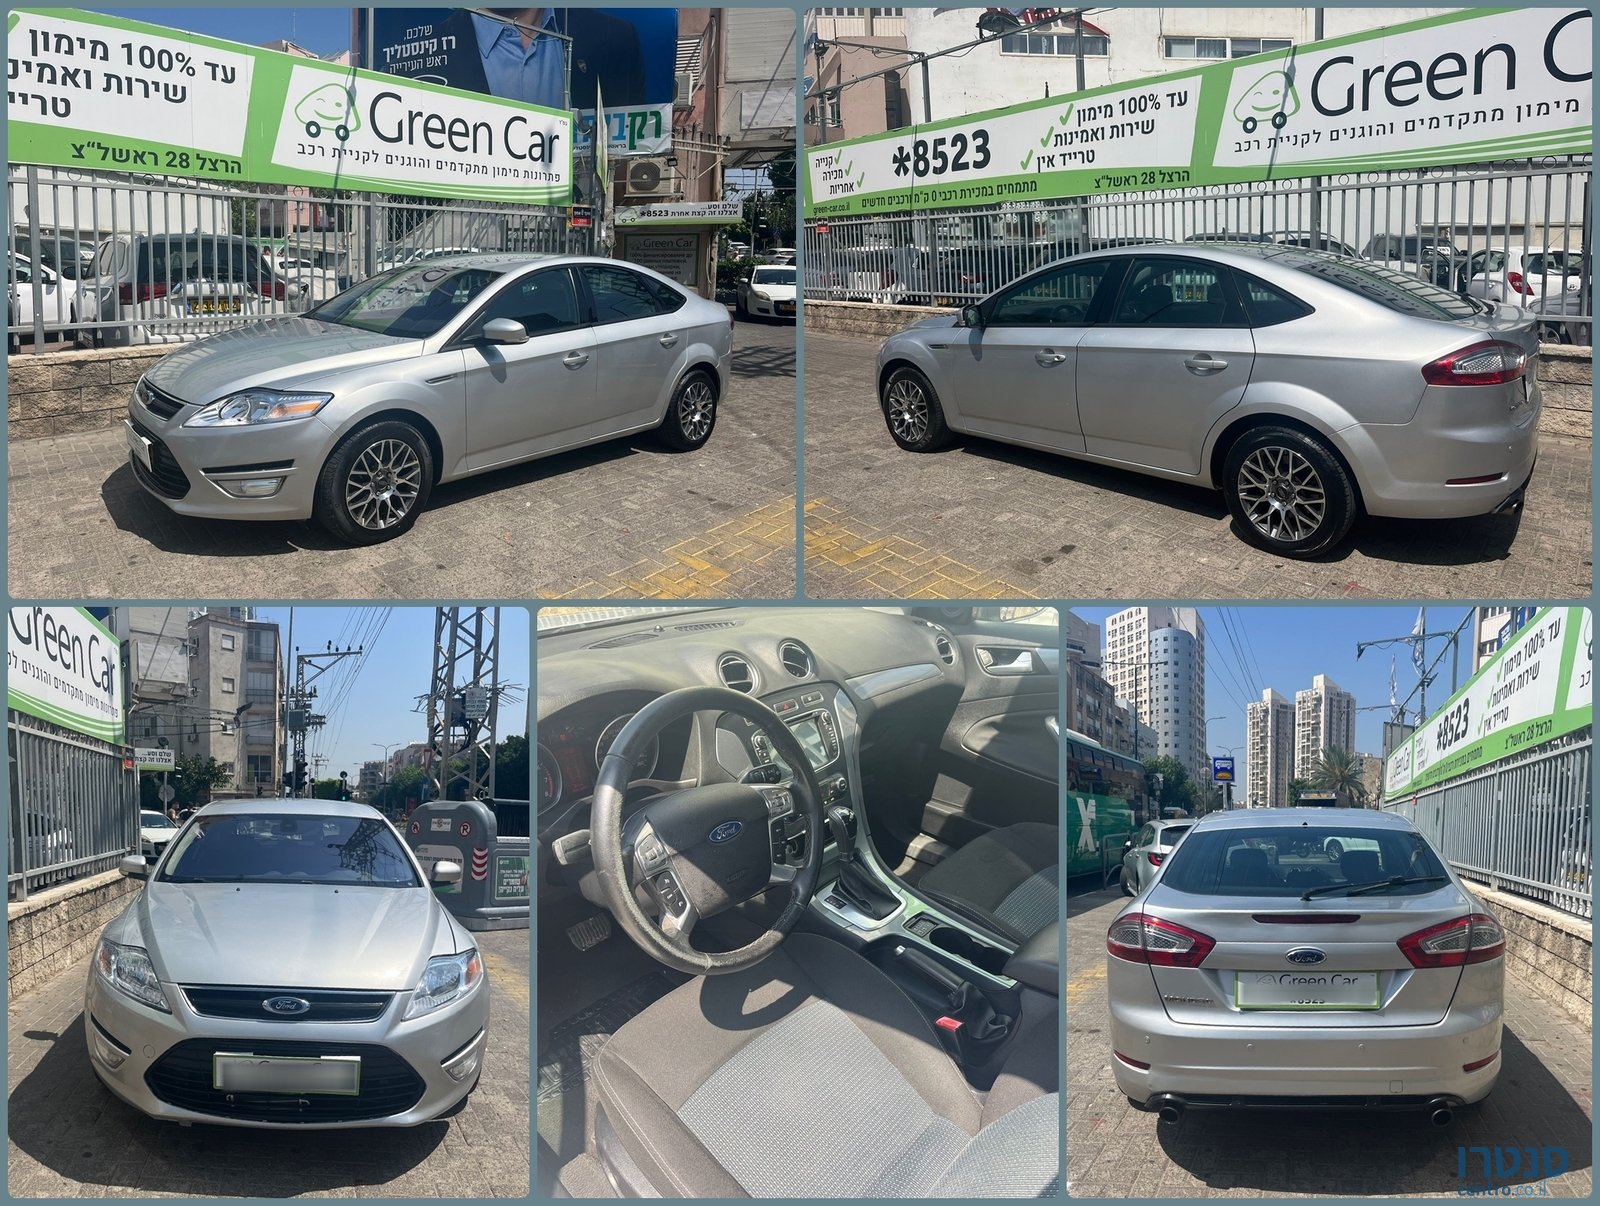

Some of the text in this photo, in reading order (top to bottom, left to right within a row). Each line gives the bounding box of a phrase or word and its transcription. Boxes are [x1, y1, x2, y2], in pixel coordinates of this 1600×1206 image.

[29, 28, 236, 84] עד 100% מימון
[383, 35, 456, 63] רז קינסטליך
[389, 54, 448, 75] ראש העירייה
[102, 71, 187, 104] שירות
[1310, 42, 1517, 117] Green
[1077, 91, 1188, 127] עד 100% מימון
[369, 91, 493, 156] Green
[504, 115, 560, 163] Car
[1053, 119, 1155, 147] שירות ואמינות
[1234, 99, 1580, 153] מימון מתקדמים והוגנים לקניית רכב
[71, 141, 242, 175] הרצל 28 ראשל"צ
[297, 143, 561, 182] פתרונות מימון מתקדמים והוגנים לקניית רכב
[815, 156, 833, 169] קנייה
[1037, 149, 1095, 173] טרייד אין
[822, 168, 844, 181] מכירה
[1094, 170, 1190, 189] הרצל 28 ראשל"צ
[829, 182, 854, 195] אחריות
[914, 190, 929, 204] ק"מ
[940, 189, 957, 201] רכבי
[959, 186, 994, 200] במכירת
[996, 180, 1037, 196] מתמחים
[813, 202, 851, 216] green-car.co.il
[862, 197, 886, 208] חדשים
[888, 194, 912, 206] ורכבים
[691, 210, 706, 218] קצת
[643, 238, 693, 248] Green Car
[1503, 617, 1561, 682] עד 100% מימון
[22, 659, 51, 686] והוגנים
[89, 634, 115, 696] Car
[54, 676, 83, 701] מתקדמים
[1491, 660, 1540, 708] שירות ואמינות
[1493, 706, 1509, 727] טרייד
[1526, 724, 1534, 741] 28
[1535, 719, 1552, 736] הרצל
[716, 824, 736, 841] Ford
[1293, 952, 1317, 963] Ford
[275, 1000, 297, 1010] Ford
